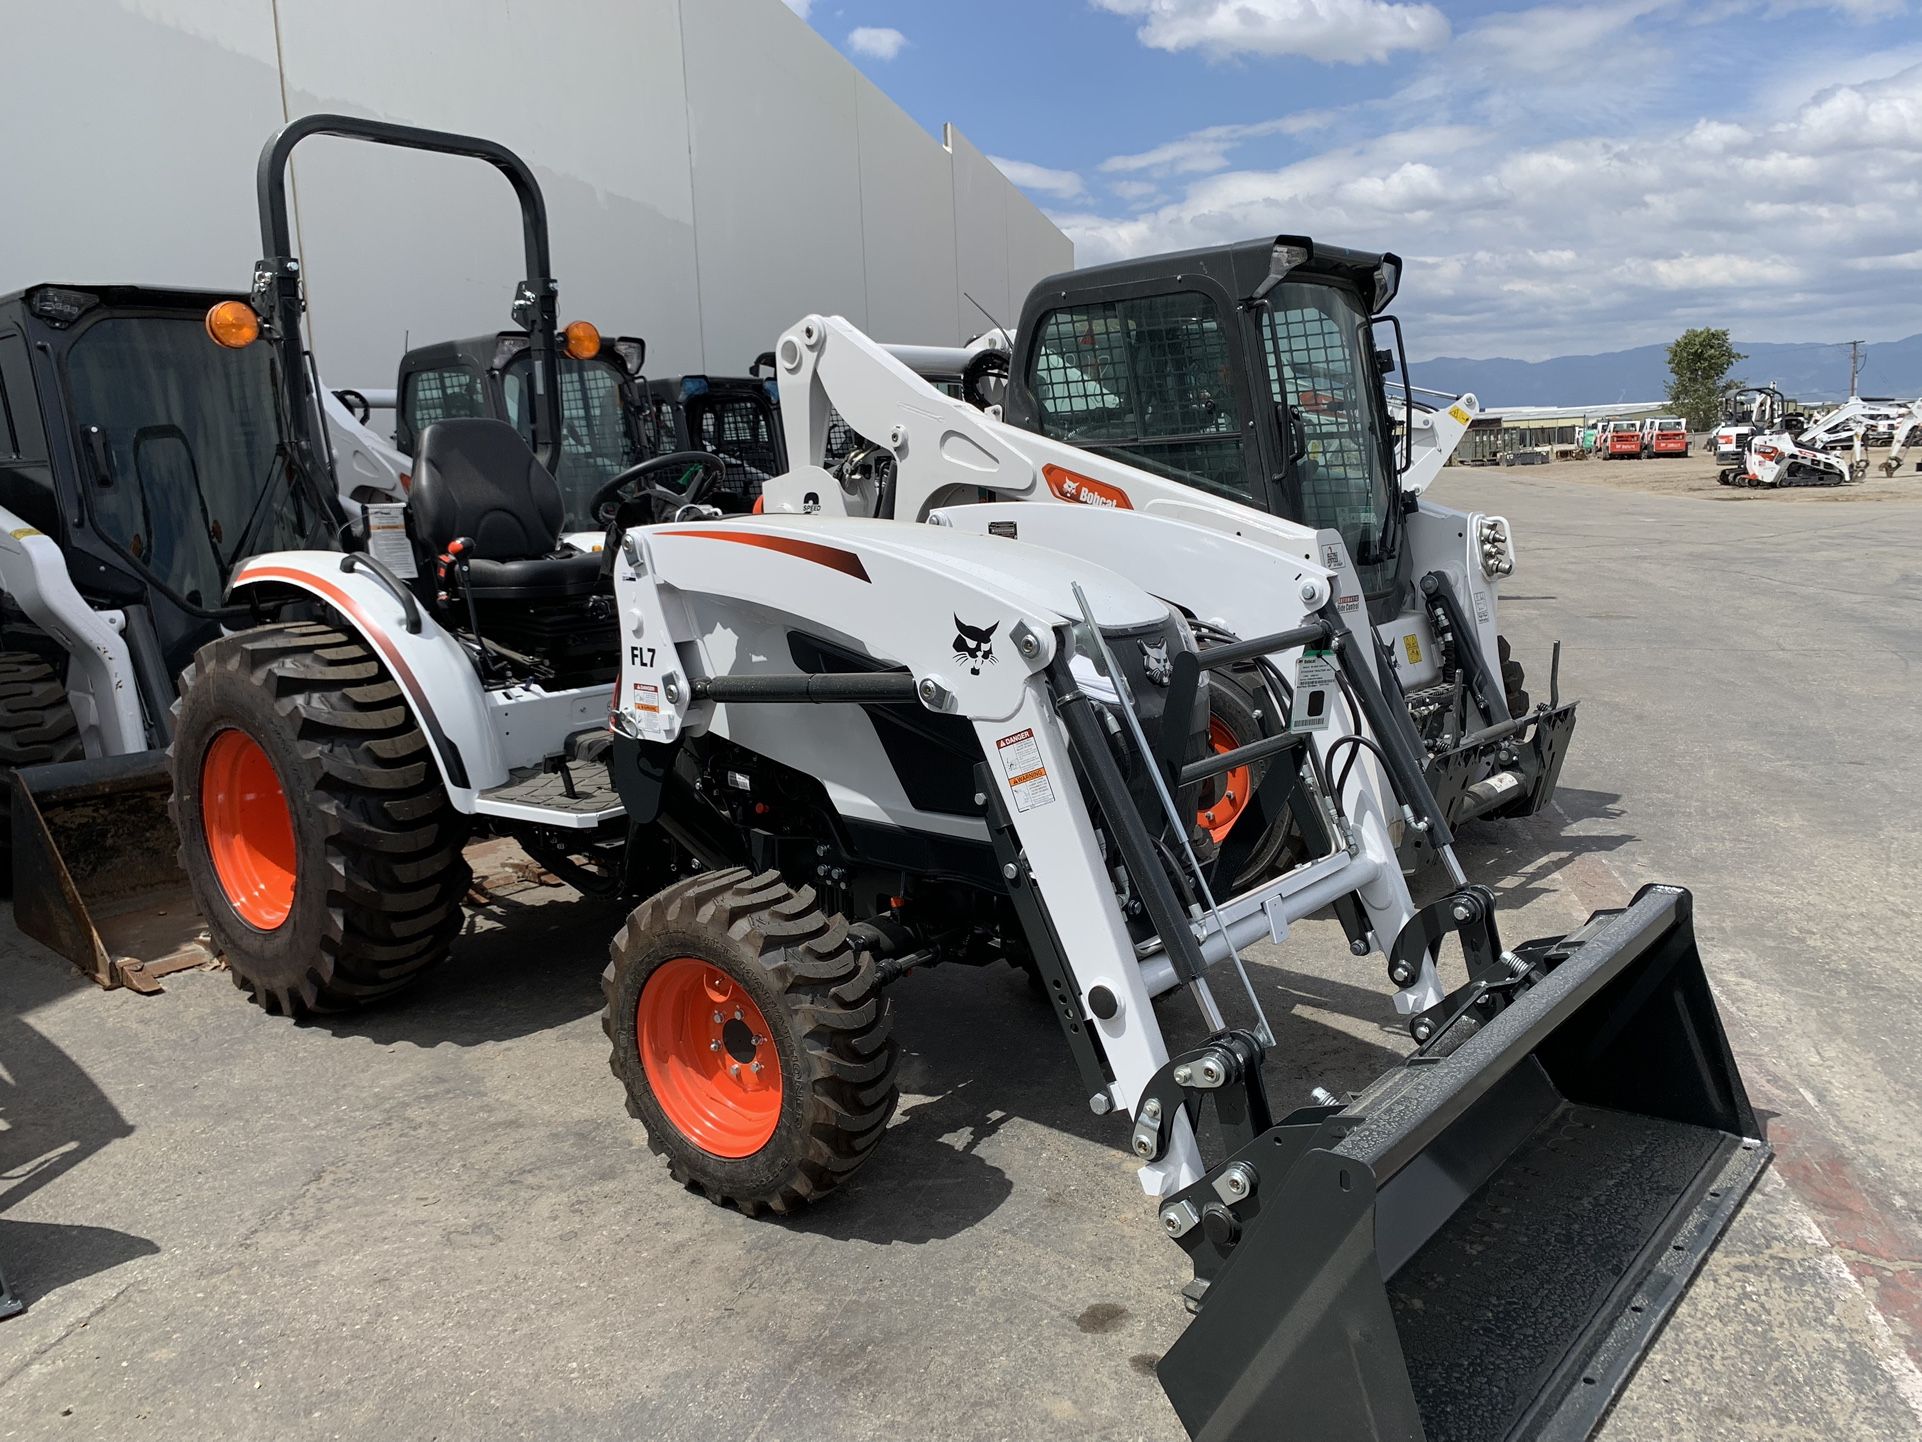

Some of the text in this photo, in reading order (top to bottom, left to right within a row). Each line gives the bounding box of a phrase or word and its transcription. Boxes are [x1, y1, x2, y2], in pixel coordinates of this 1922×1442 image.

[1079, 486, 1117, 508] Bobcat
[802, 504, 822, 512] SPEED
[631, 646, 656, 668] FL7
[1005, 731, 1030, 745] DANGER
[1016, 769, 1043, 783] WARNING
